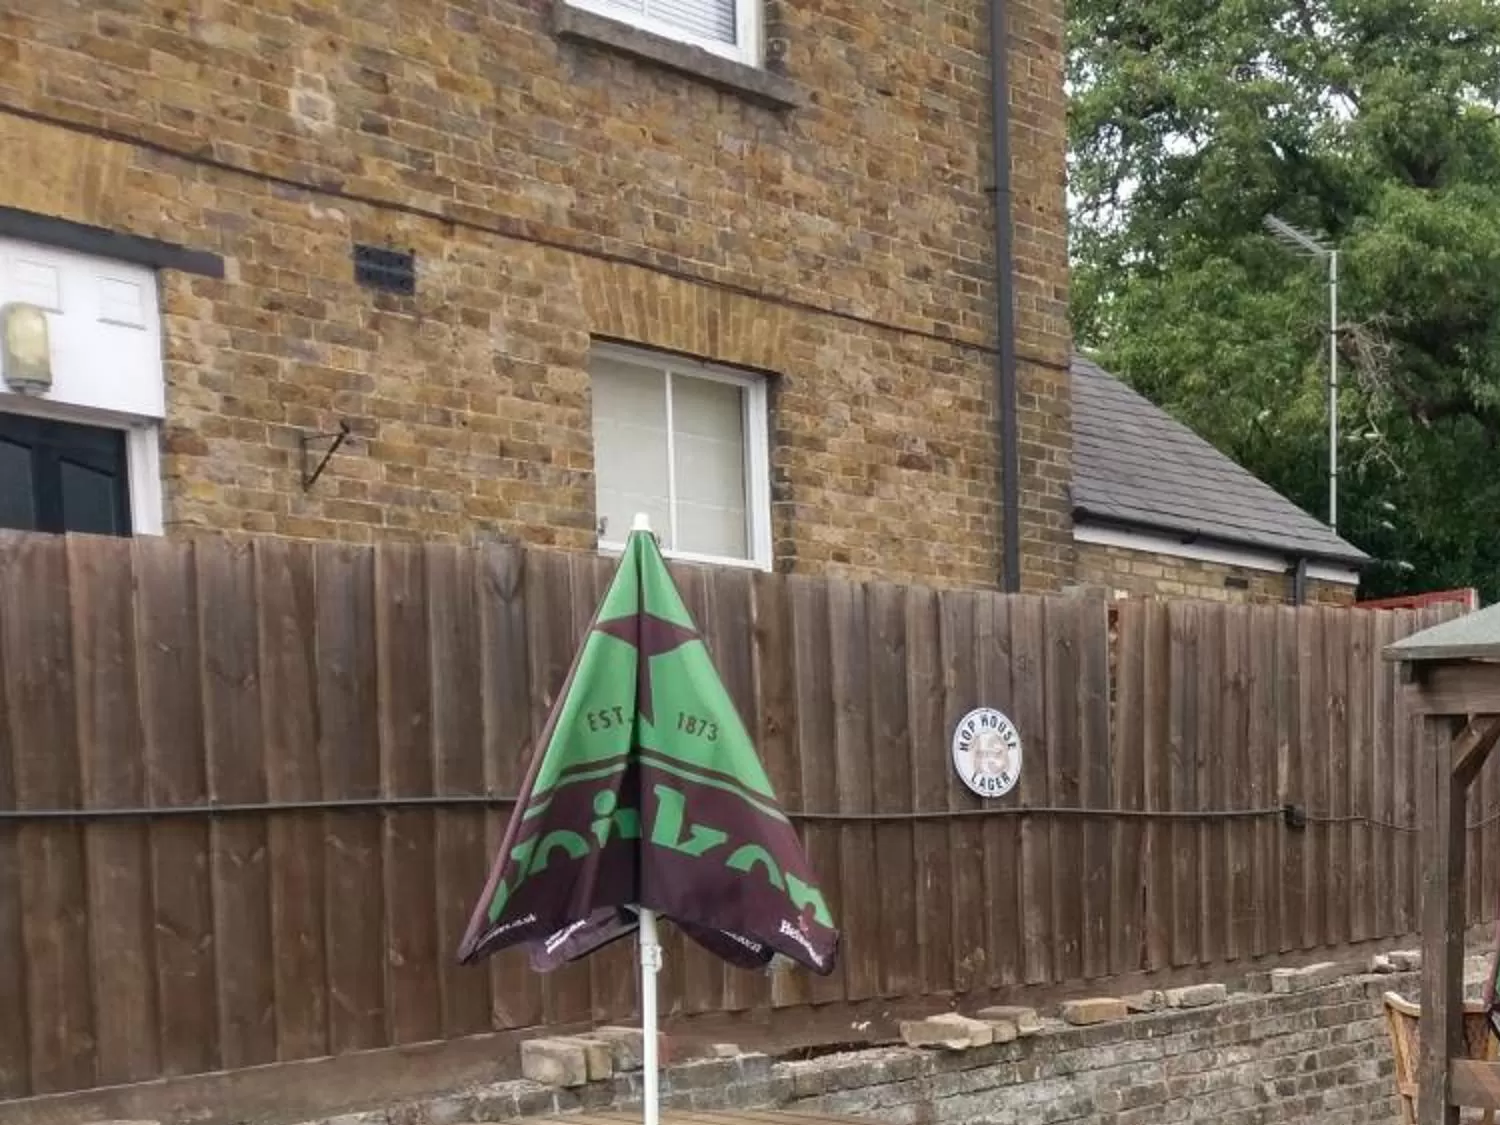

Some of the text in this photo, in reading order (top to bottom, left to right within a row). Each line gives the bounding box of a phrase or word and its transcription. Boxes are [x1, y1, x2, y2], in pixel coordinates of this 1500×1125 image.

[677, 711, 719, 742] 1873
[959, 714, 1017, 752] HOP HOUSE
[971, 771, 1011, 791] LAGER
